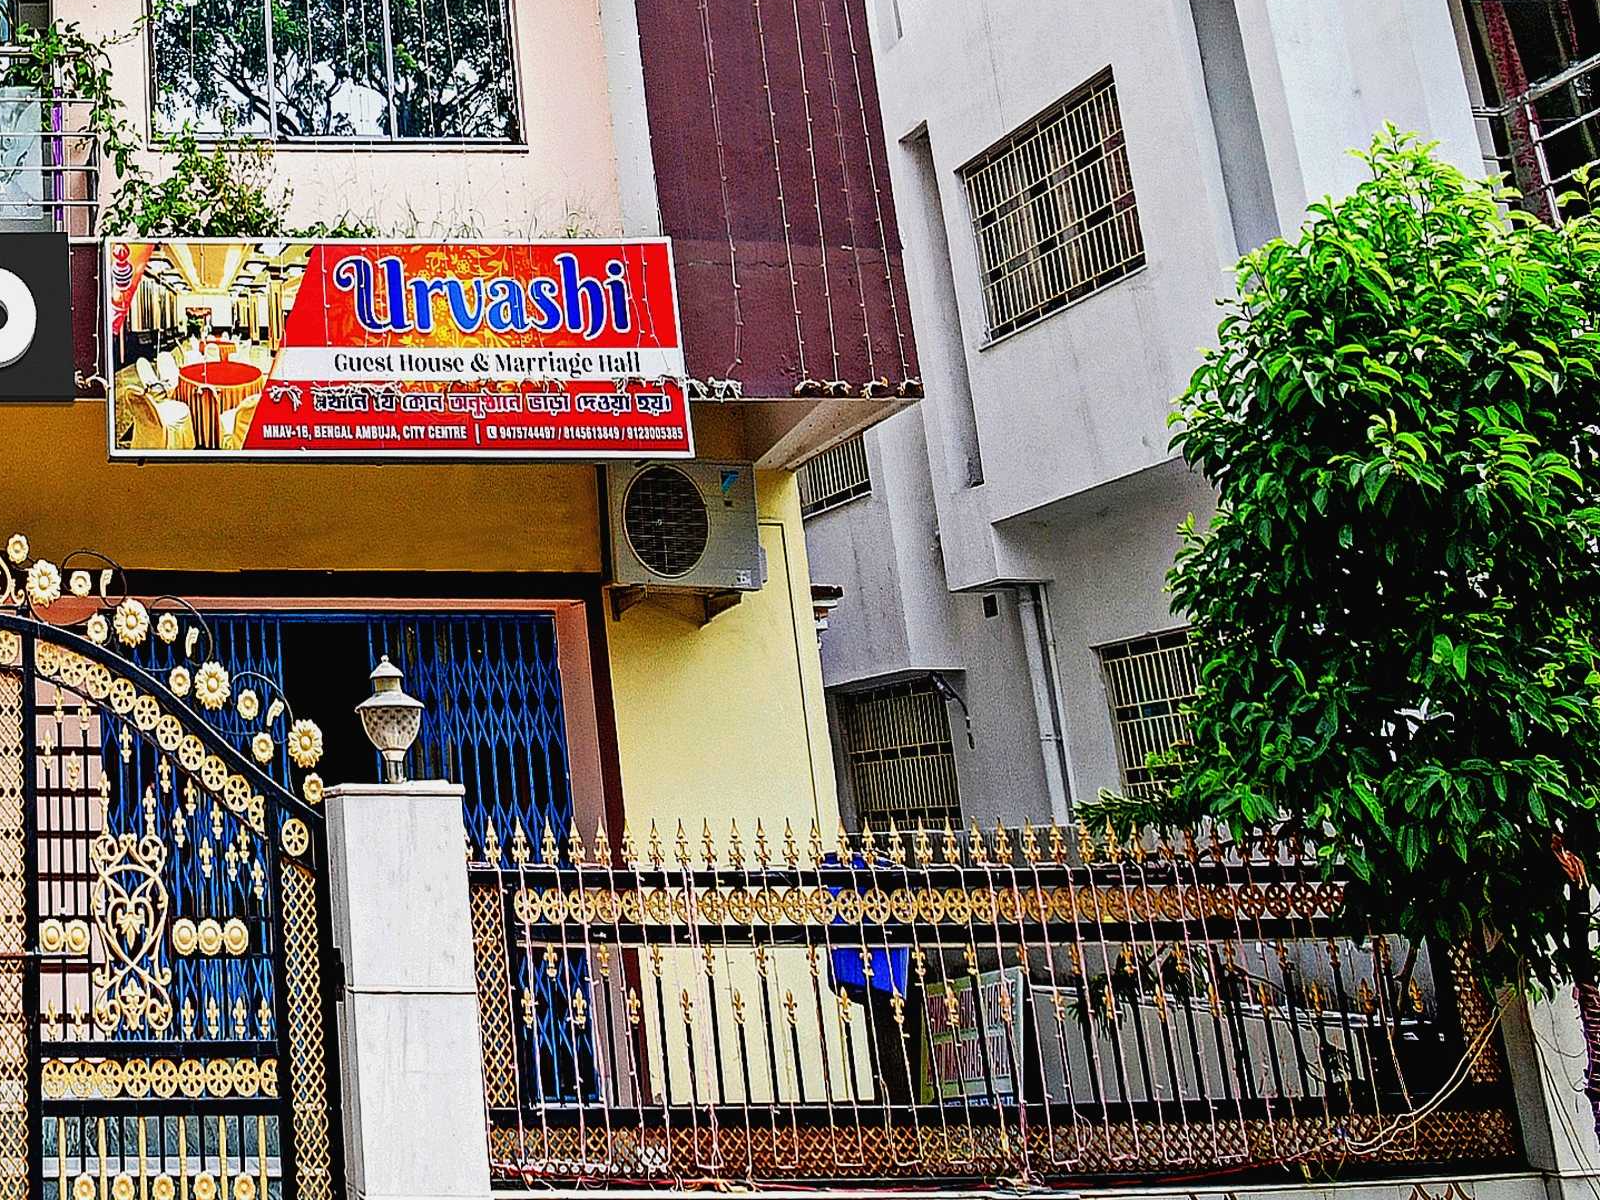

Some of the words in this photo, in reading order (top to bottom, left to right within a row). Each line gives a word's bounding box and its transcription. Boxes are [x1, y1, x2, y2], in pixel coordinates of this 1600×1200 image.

[334, 253, 632, 340] Urvashi
[334, 352, 394, 373] Guest
[400, 353, 464, 373] House
[470, 353, 490, 373] &
[495, 353, 593, 379] Marriage
[599, 351, 641, 373] Hall
[401, 392, 445, 412] কোন
[314, 425, 354, 440] BENGAL
[355, 425, 400, 441] AMBUJA,
[402, 425, 427, 440] CITY
[428, 425, 468, 440] CENTRE
